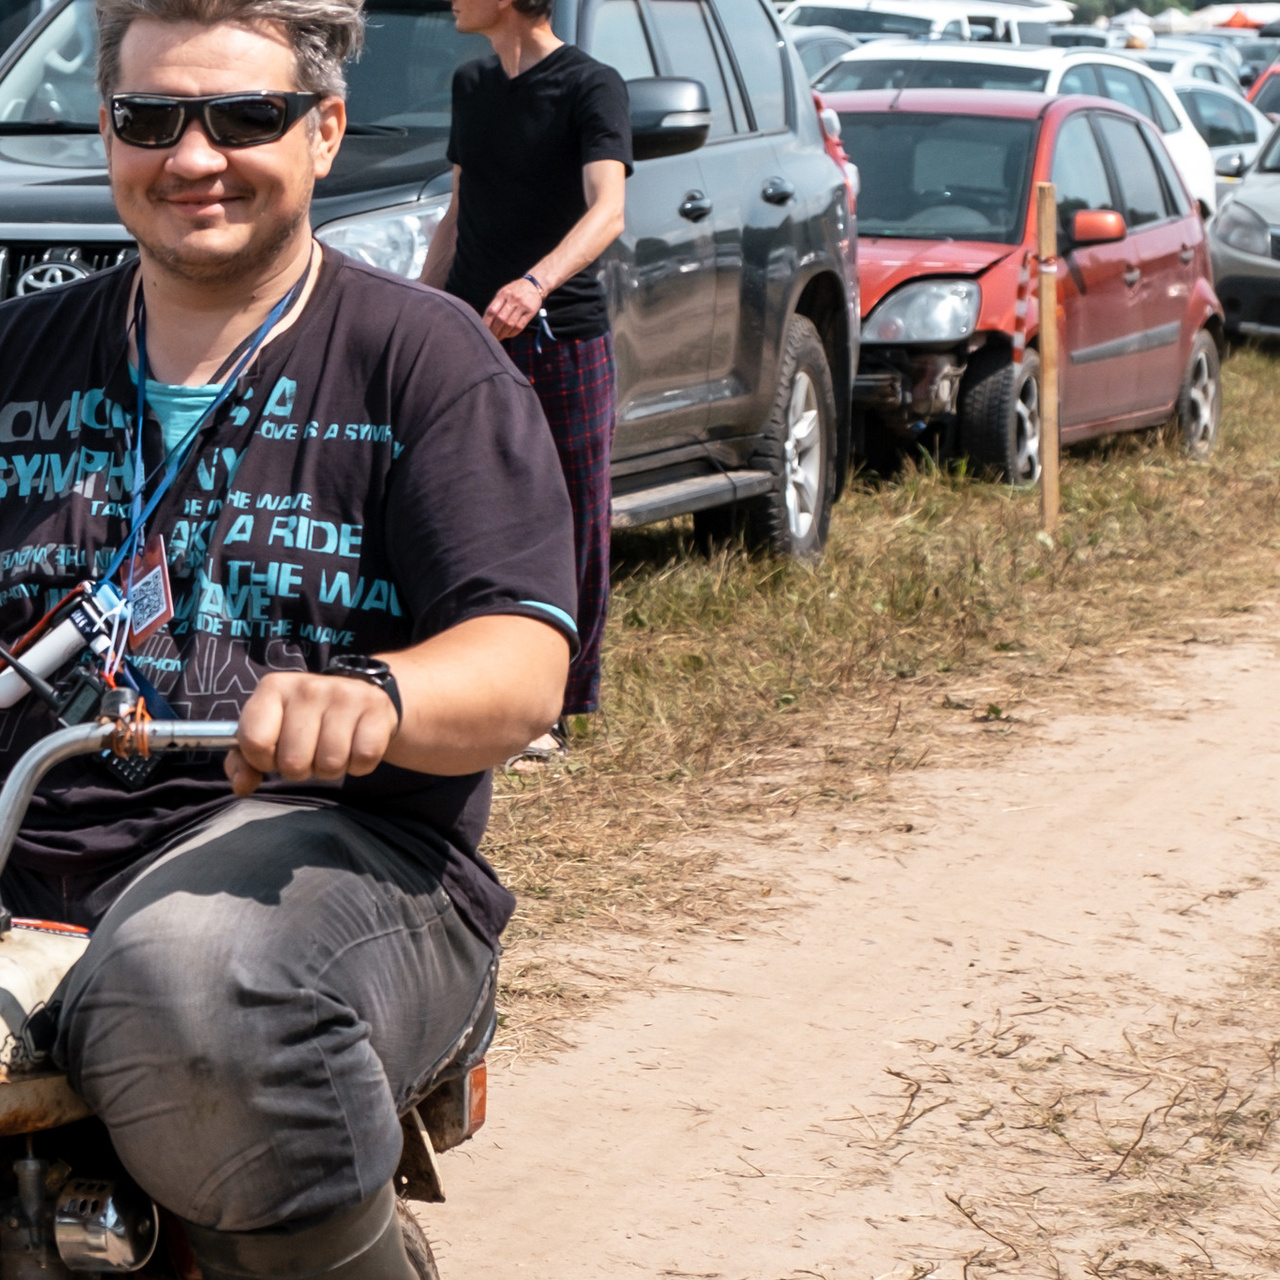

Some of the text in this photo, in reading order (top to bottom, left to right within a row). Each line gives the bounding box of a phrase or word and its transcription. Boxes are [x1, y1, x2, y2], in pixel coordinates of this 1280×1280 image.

[323, 423, 339, 440] A
[256, 492, 312, 512] WAVE
[223, 515, 254, 545] A
[269, 515, 363, 558] RIDE
[227, 561, 303, 598] THE
[299, 623, 356, 647] WAVE
